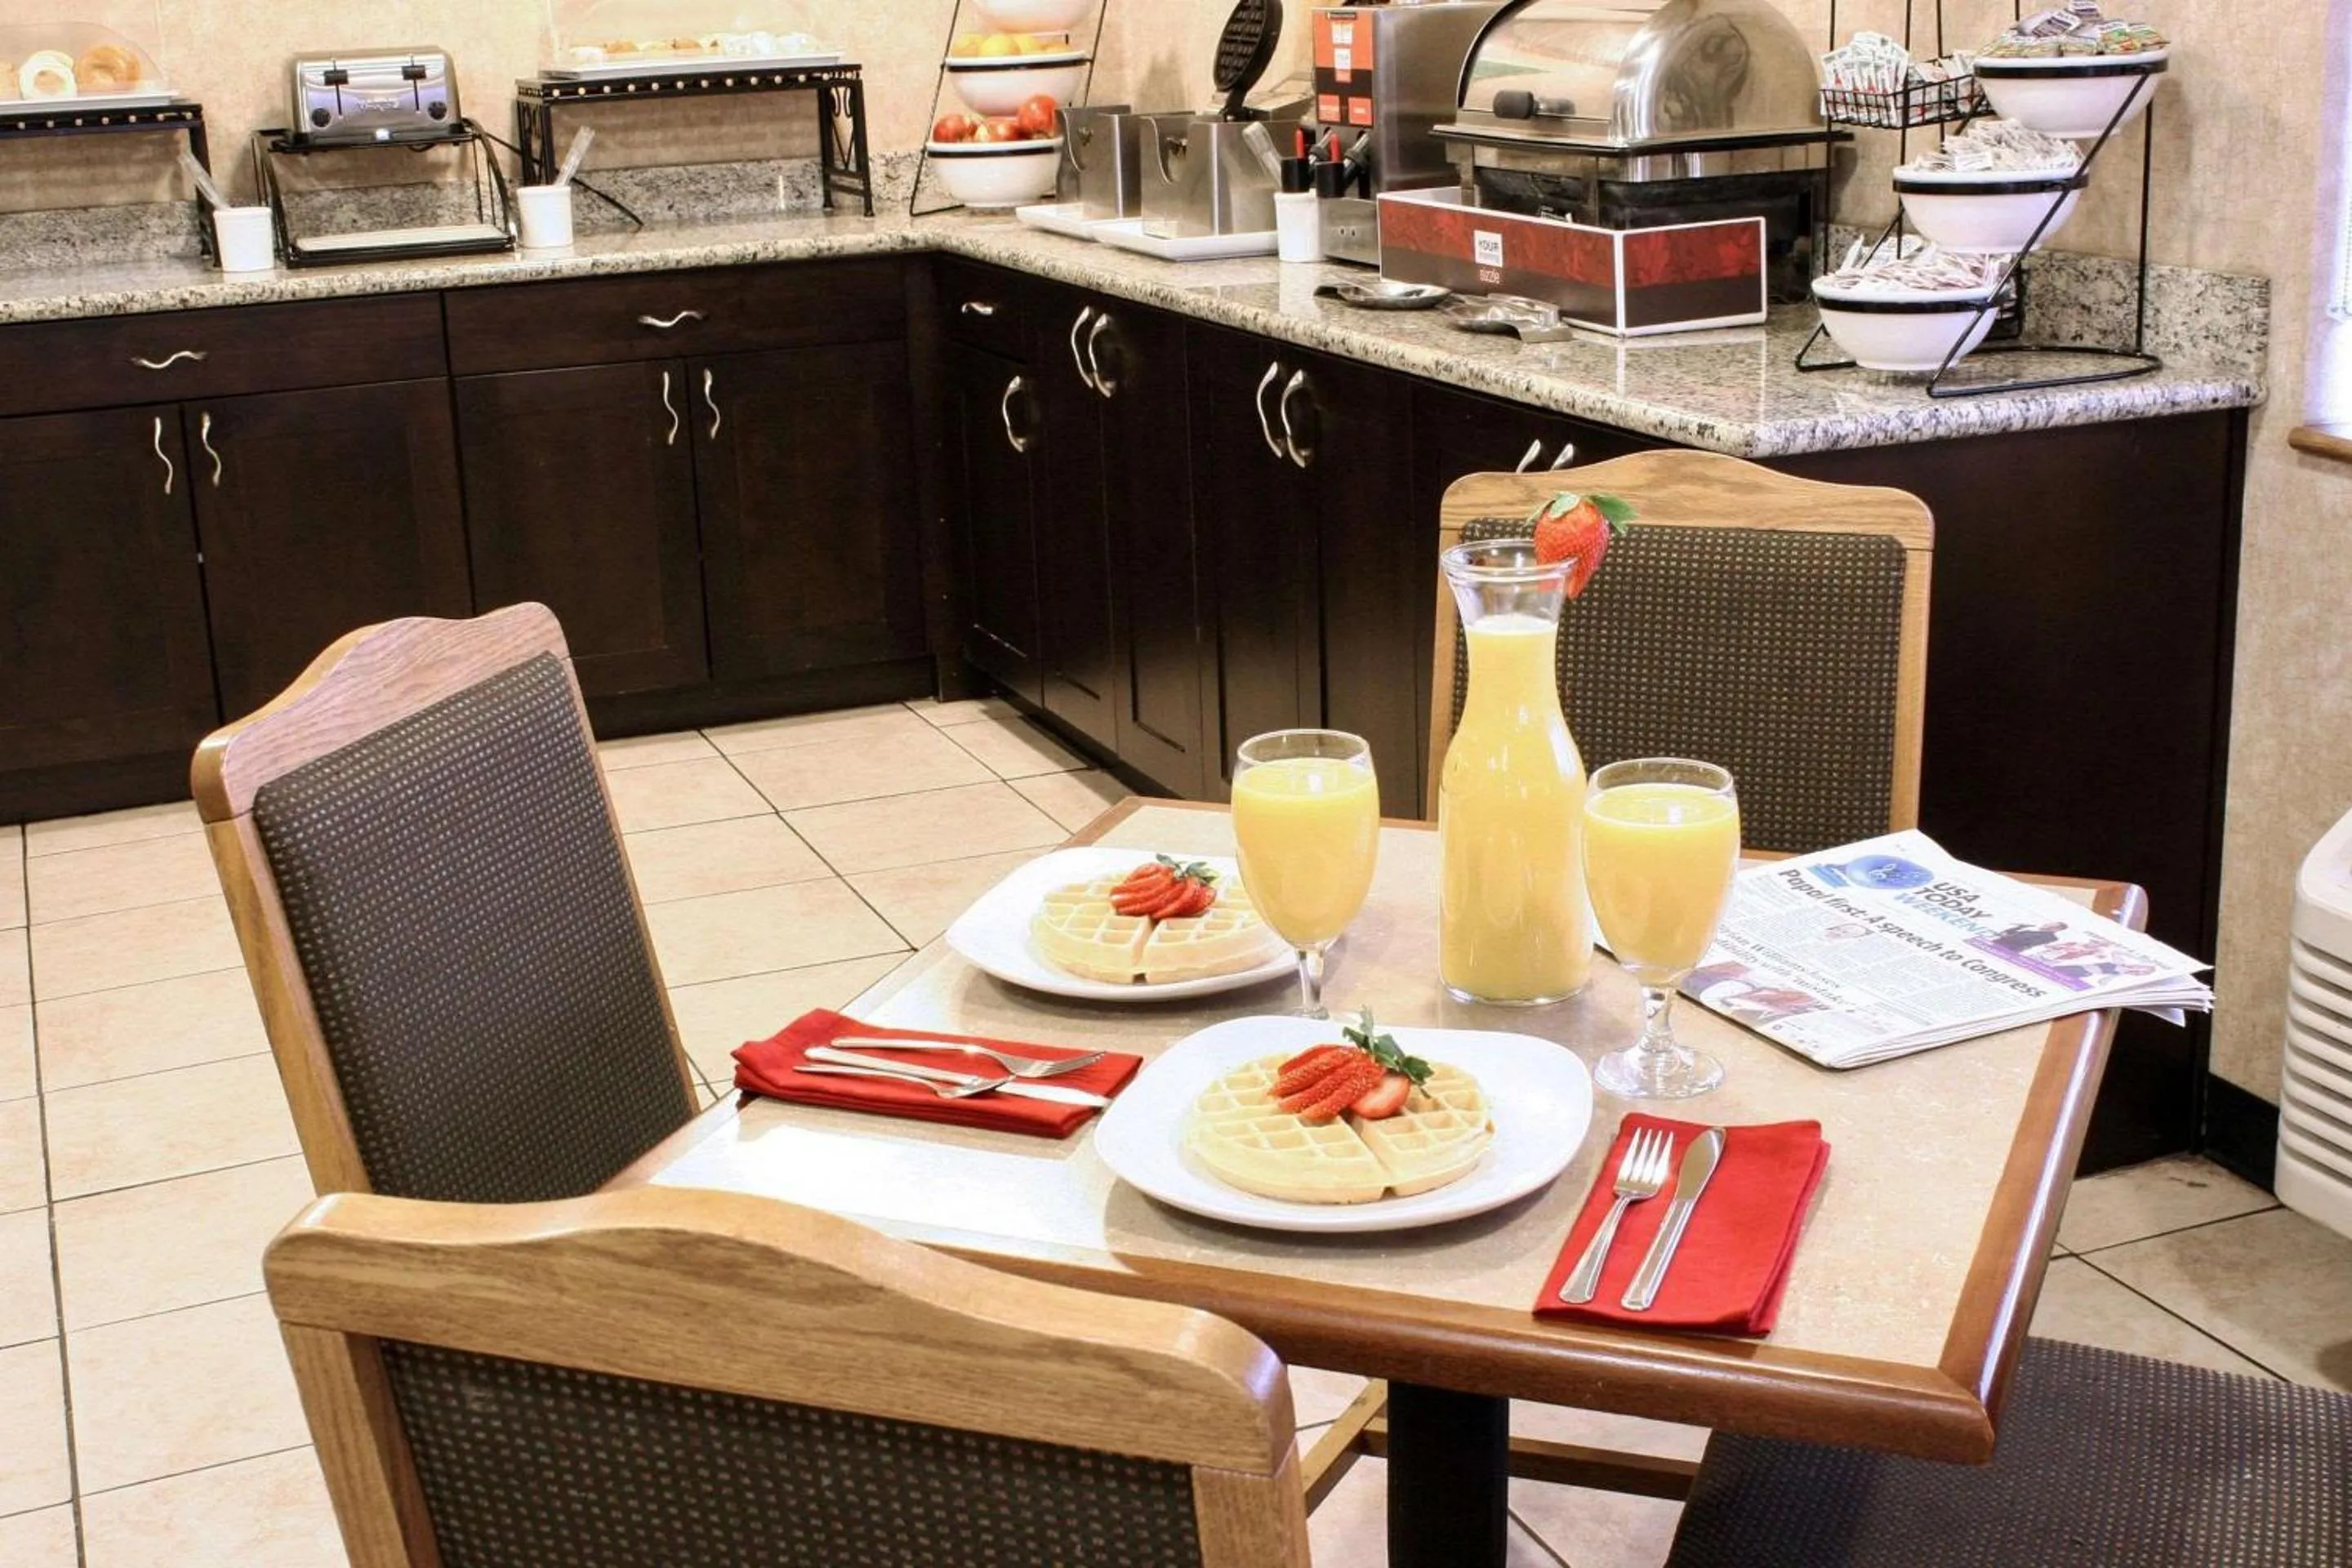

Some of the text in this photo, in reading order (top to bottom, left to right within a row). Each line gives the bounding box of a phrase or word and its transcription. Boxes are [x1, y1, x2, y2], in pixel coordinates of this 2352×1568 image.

[1913, 887, 1994, 920] TODAY
[1933, 882, 1981, 903] USA
[1777, 869, 1835, 899] Papal
[1863, 915, 1886, 924] A
[1877, 922, 1944, 952] speech
[1938, 950, 1964, 961] to
[1961, 959, 2048, 999] Congress
